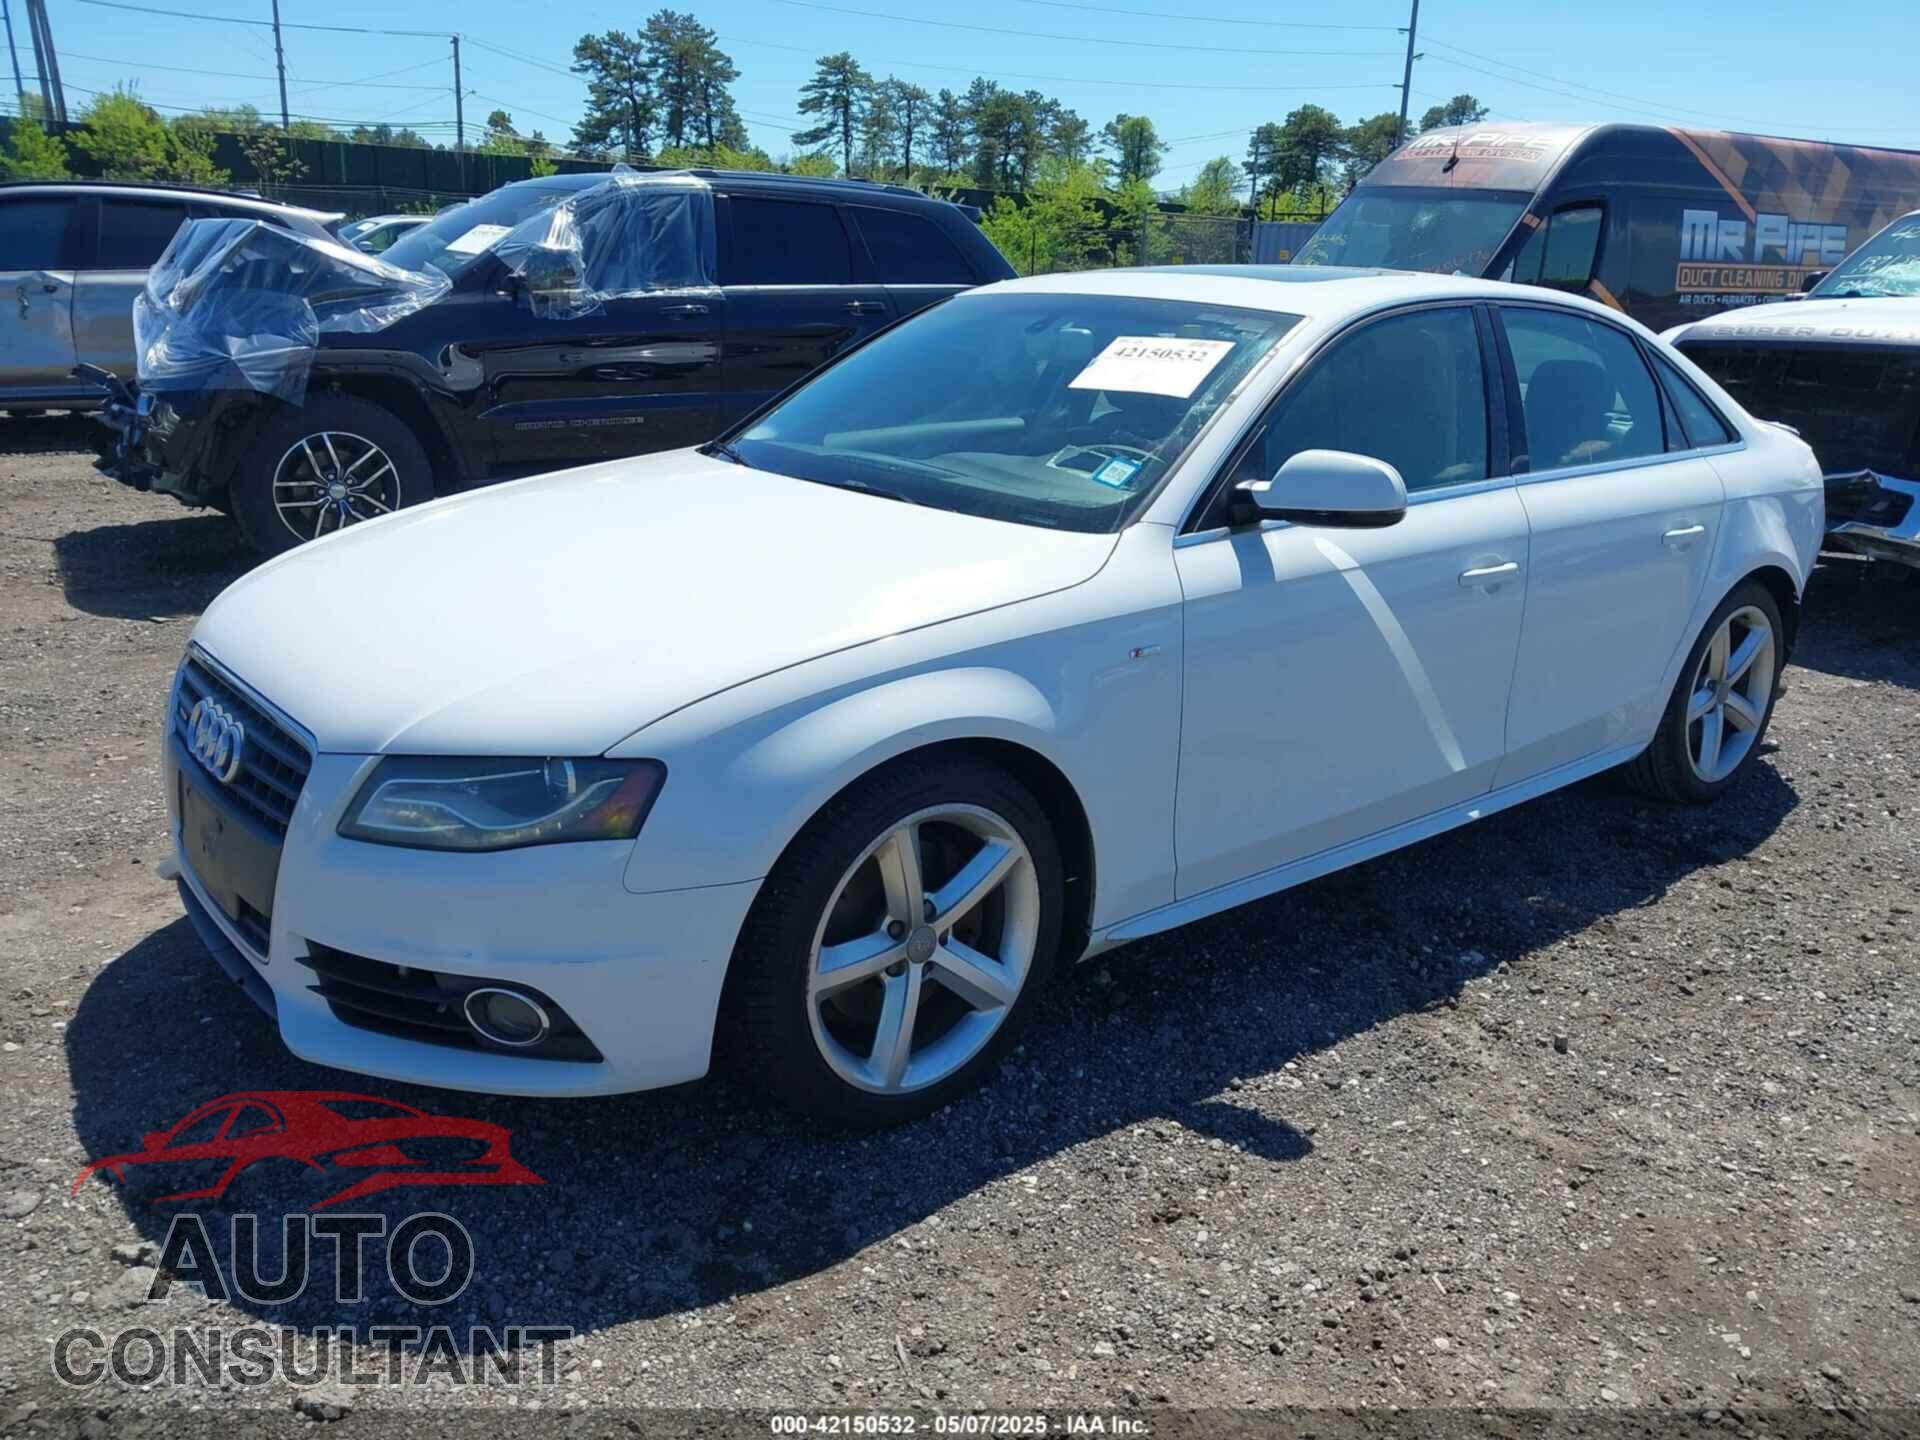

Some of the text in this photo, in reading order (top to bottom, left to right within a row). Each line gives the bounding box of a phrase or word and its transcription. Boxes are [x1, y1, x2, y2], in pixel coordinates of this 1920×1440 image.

[1680, 209, 1746, 262] MR
[1754, 213, 1847, 265] PIPE
[1681, 268, 1716, 286] DUCT
[1720, 270, 1783, 287] CLEANING
[1114, 346, 1208, 362] 42150532
